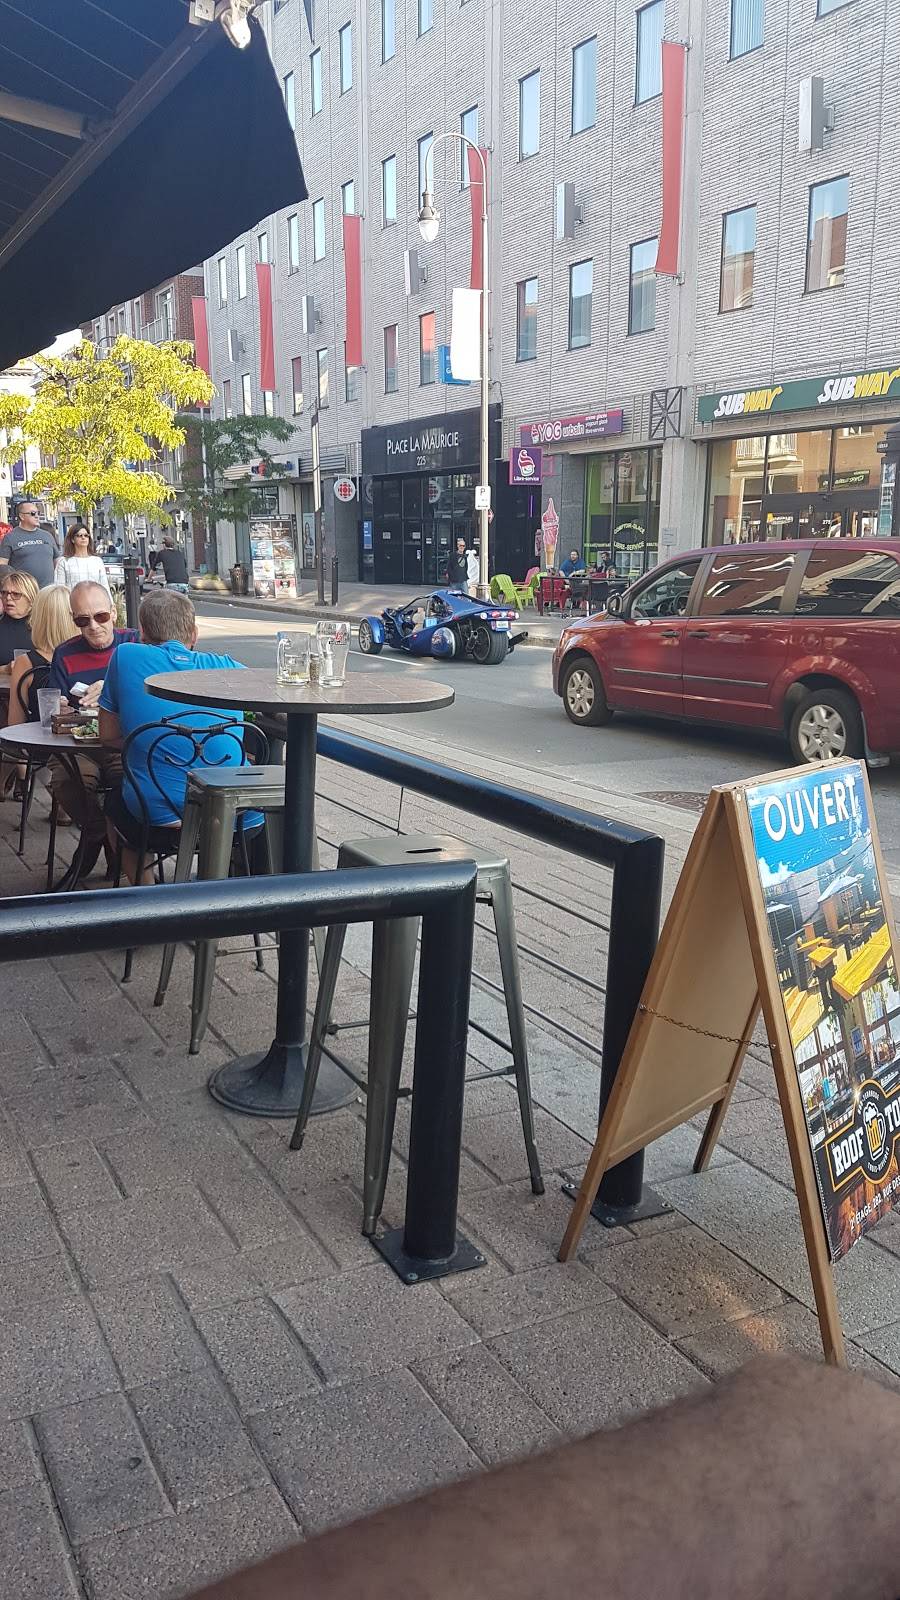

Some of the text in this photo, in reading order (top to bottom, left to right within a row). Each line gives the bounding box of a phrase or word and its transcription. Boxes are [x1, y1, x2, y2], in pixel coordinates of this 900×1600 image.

[818, 367, 900, 404] SUBWAY
[714, 386, 783, 418] SUBWAY
[387, 432, 459, 455] PLACE LA MAURICIE
[538, 421, 584, 442] YOG urbain
[417, 456, 427, 466] 225
[764, 776, 859, 842] OUVERT
[832, 1127, 864, 1177] ROOF
